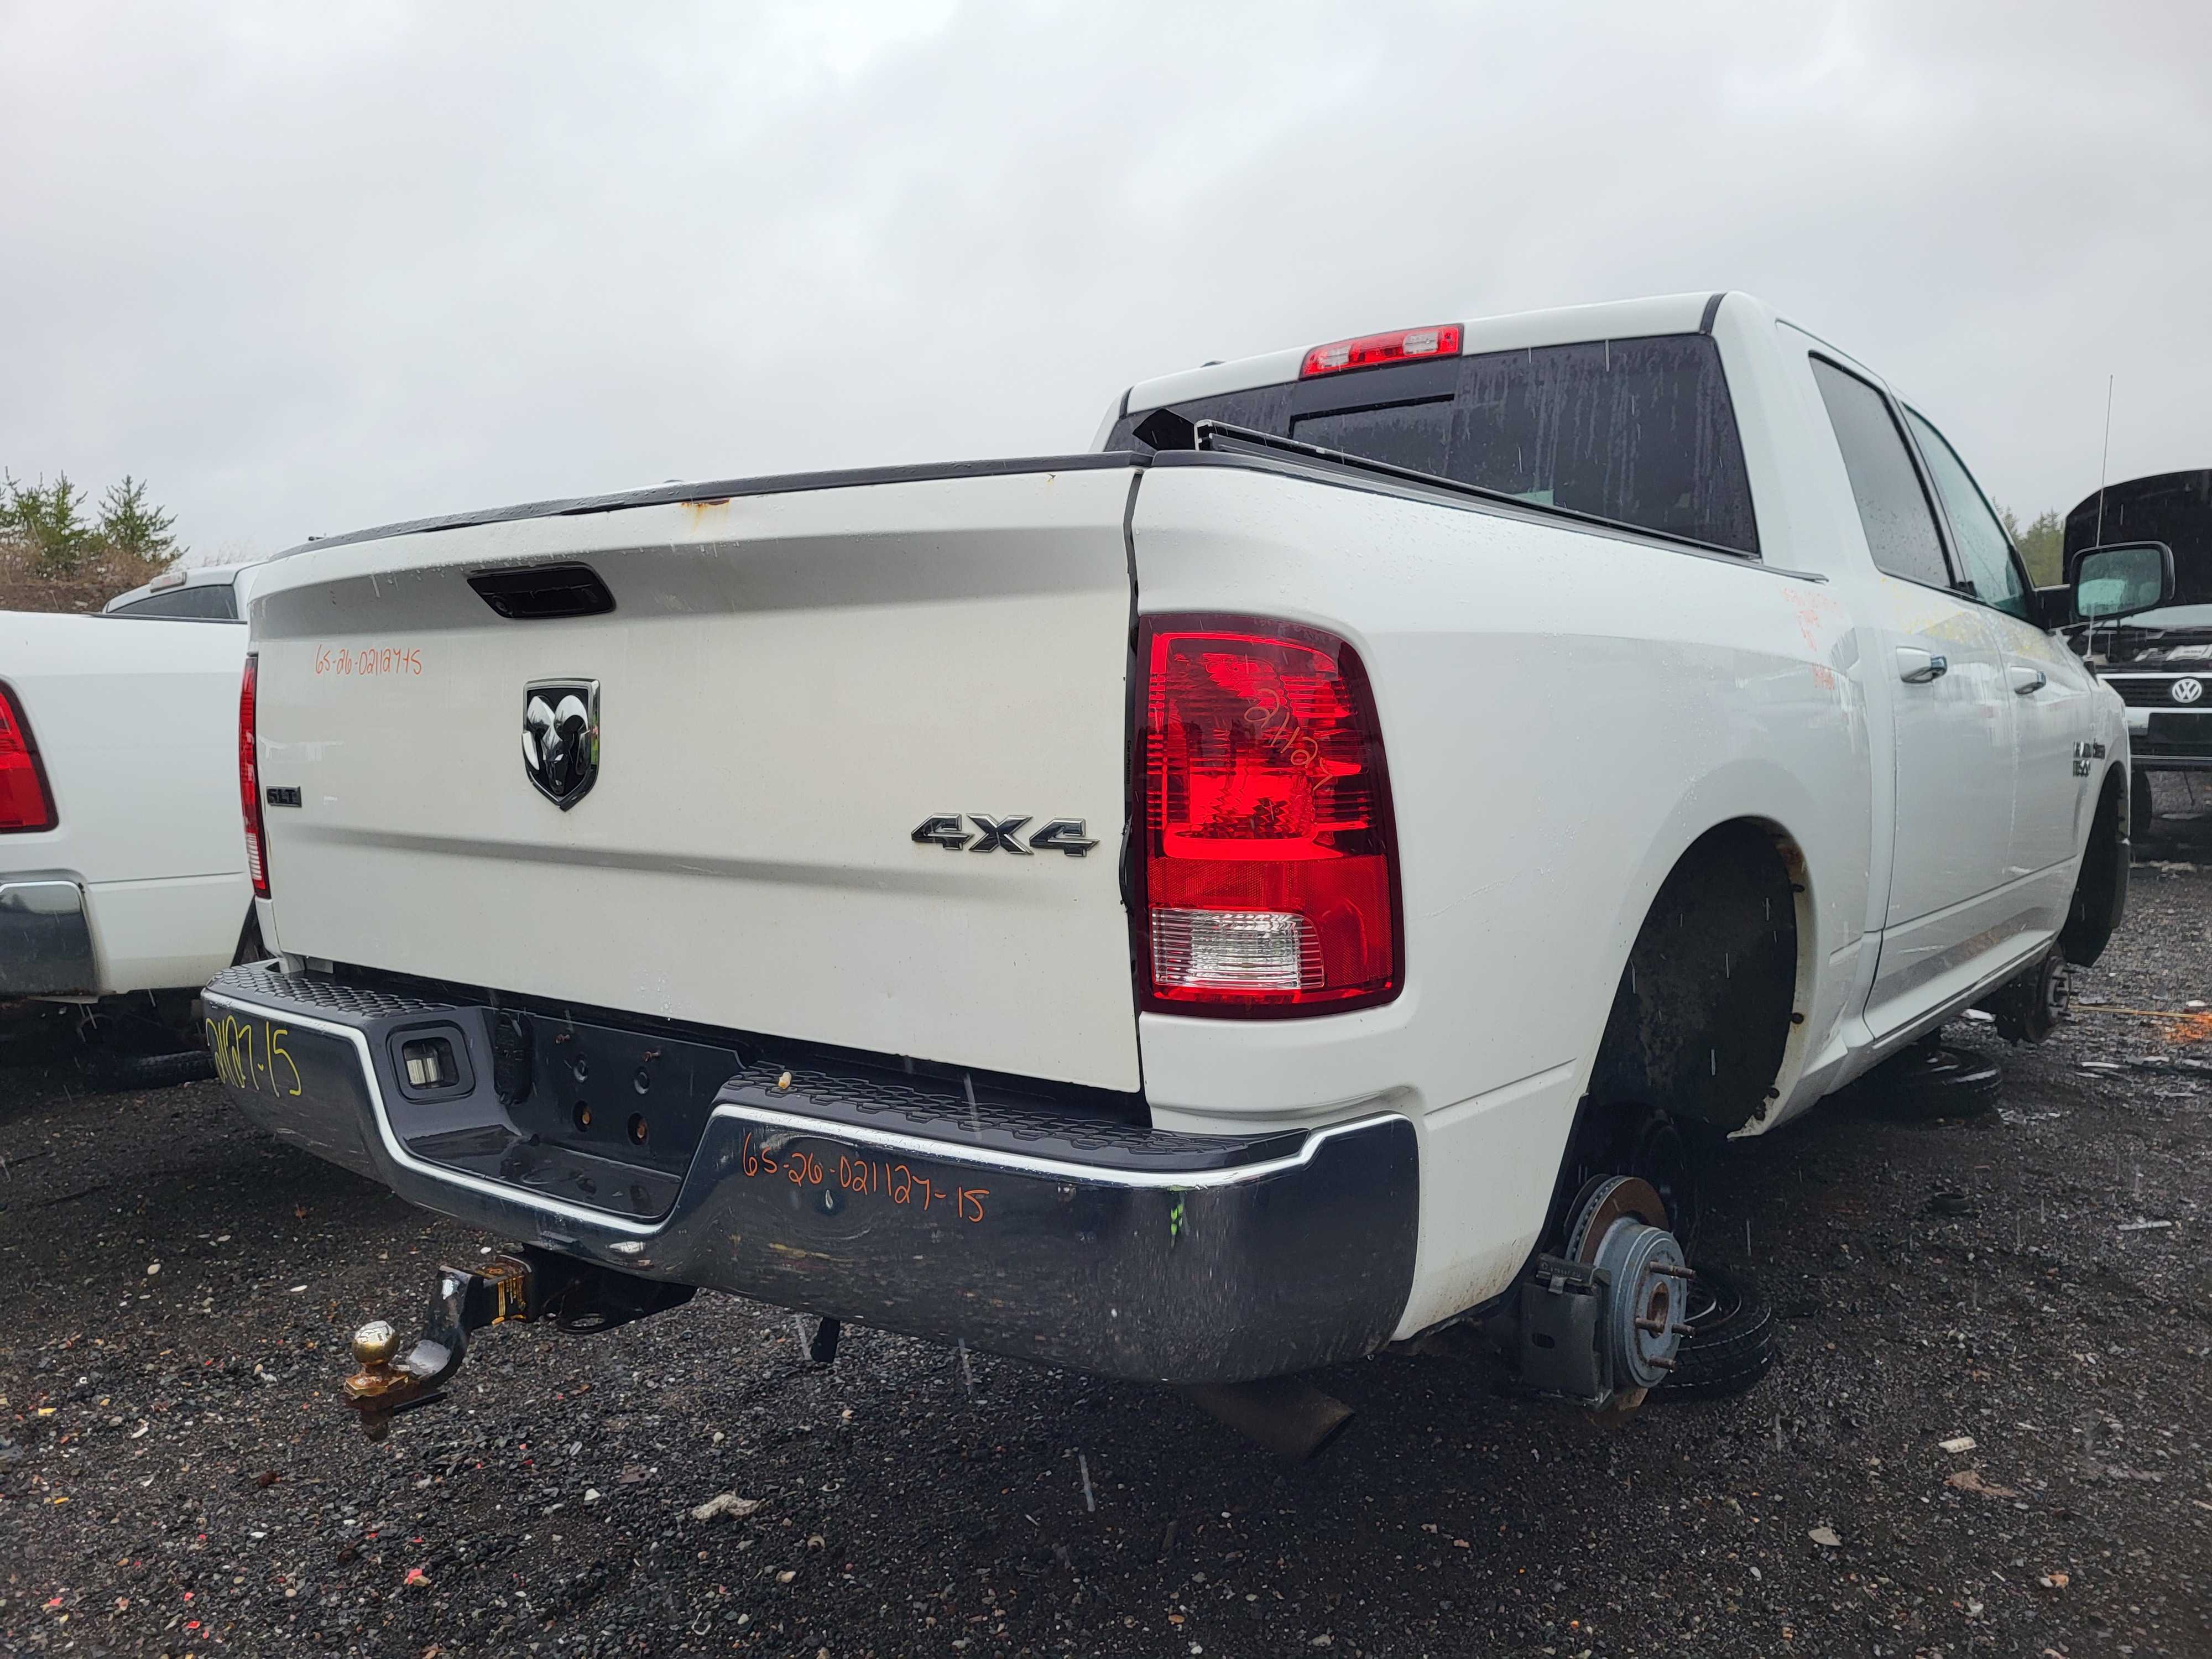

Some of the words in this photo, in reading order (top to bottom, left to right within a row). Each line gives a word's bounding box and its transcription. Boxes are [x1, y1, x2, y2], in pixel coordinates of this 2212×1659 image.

[2173, 680, 2201, 702] VW
[267, 789, 296, 804] SLT
[743, 1132, 990, 1222] 65-26-021127-15
